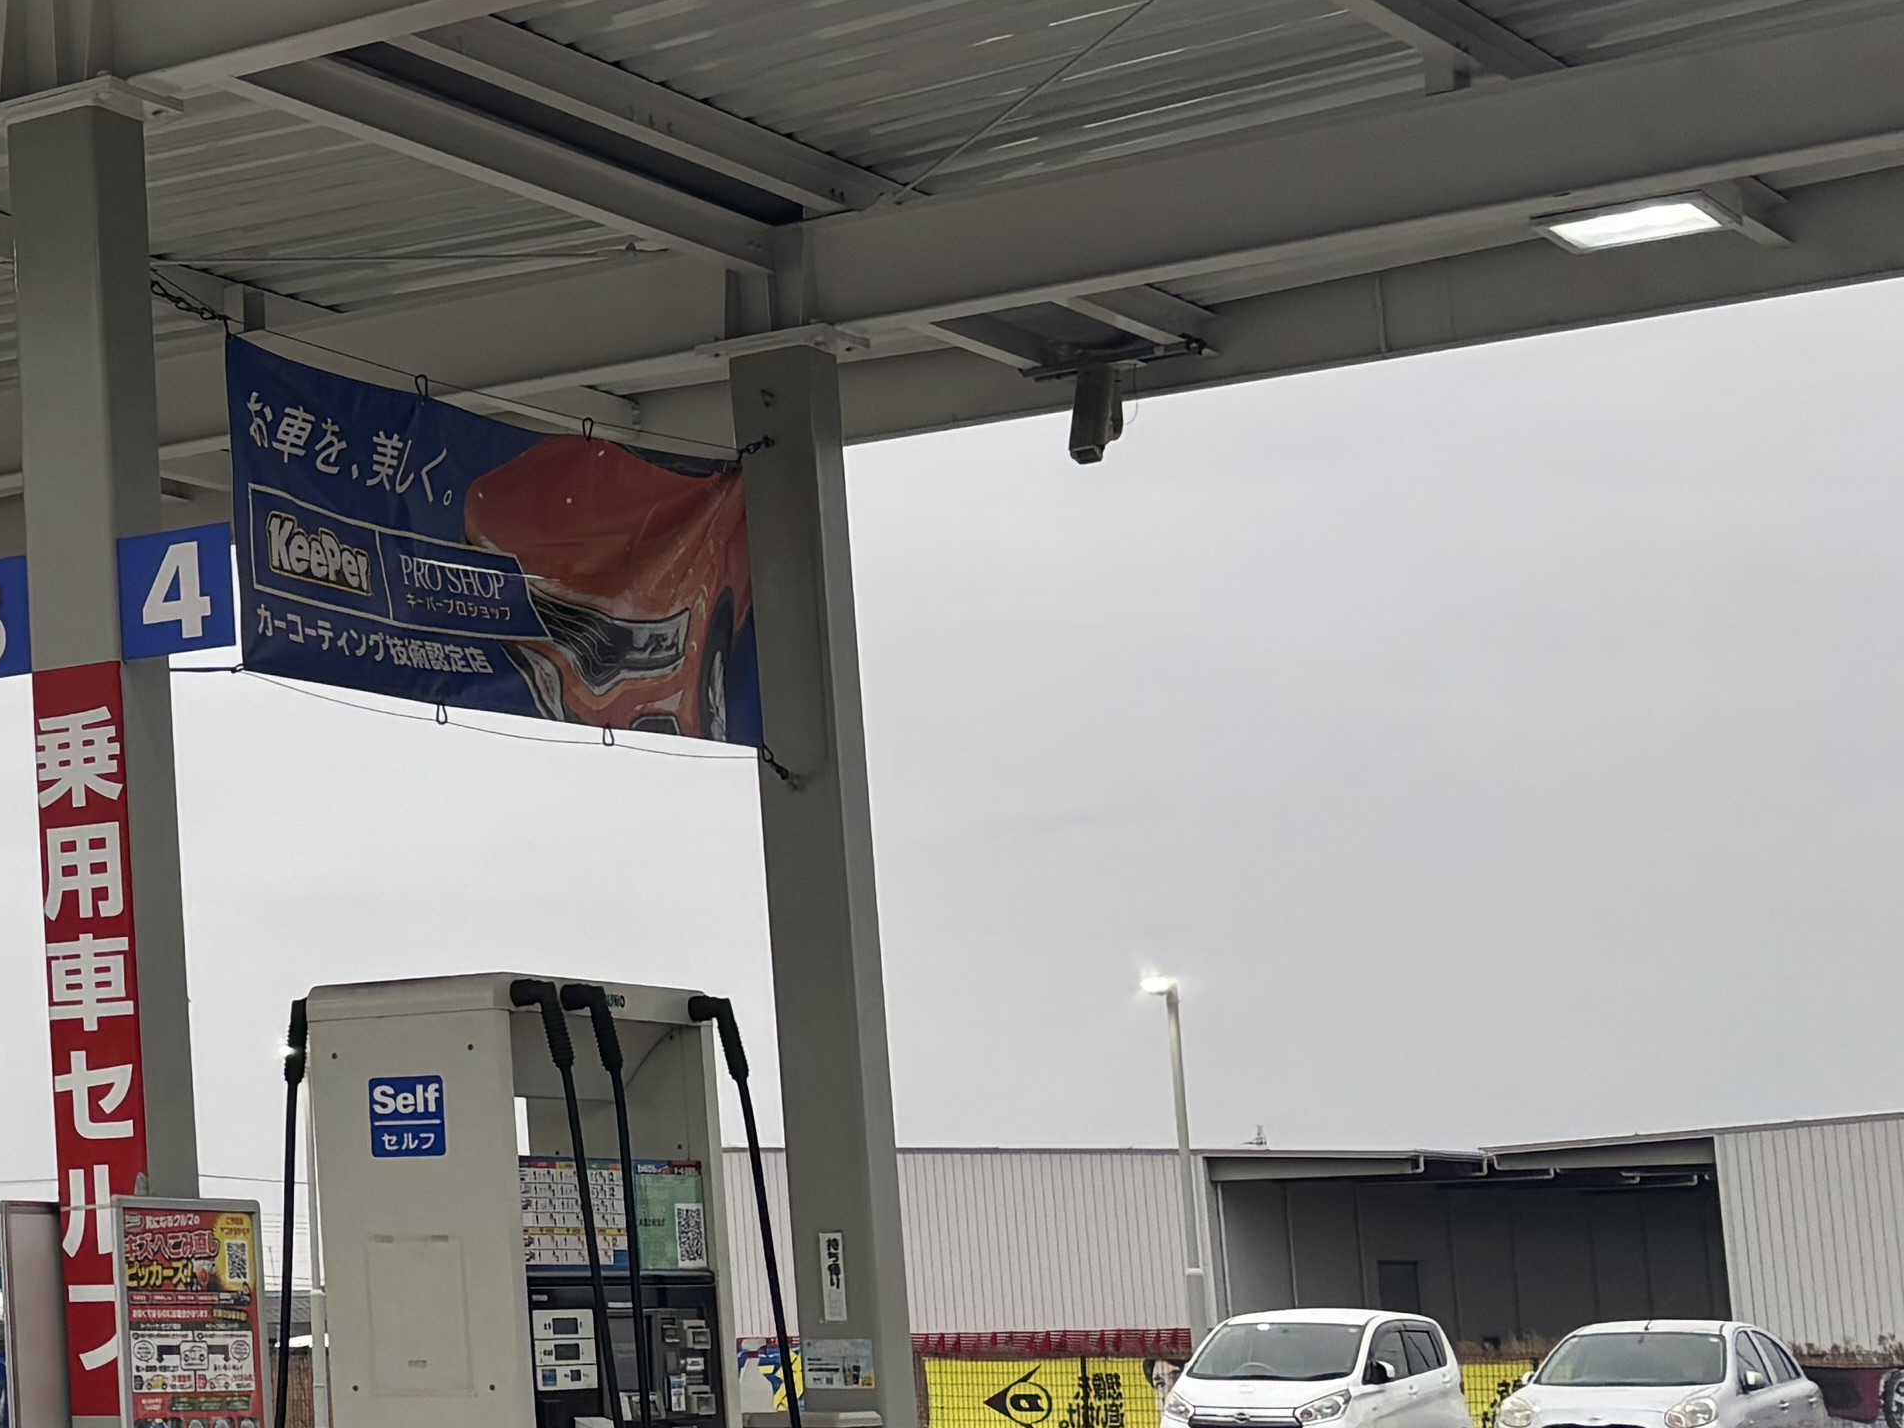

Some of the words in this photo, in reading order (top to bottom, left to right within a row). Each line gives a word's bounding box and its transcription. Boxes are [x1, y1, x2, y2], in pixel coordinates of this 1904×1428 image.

[246, 390, 452, 508] お車を、美しく。
[141, 541, 212, 639] 4
[440, 560, 506, 601] SHOP
[256, 603, 495, 674] カーコーティング技術認定店
[372, 1083, 440, 1115] Self
[381, 1132, 435, 1151] セルフ
